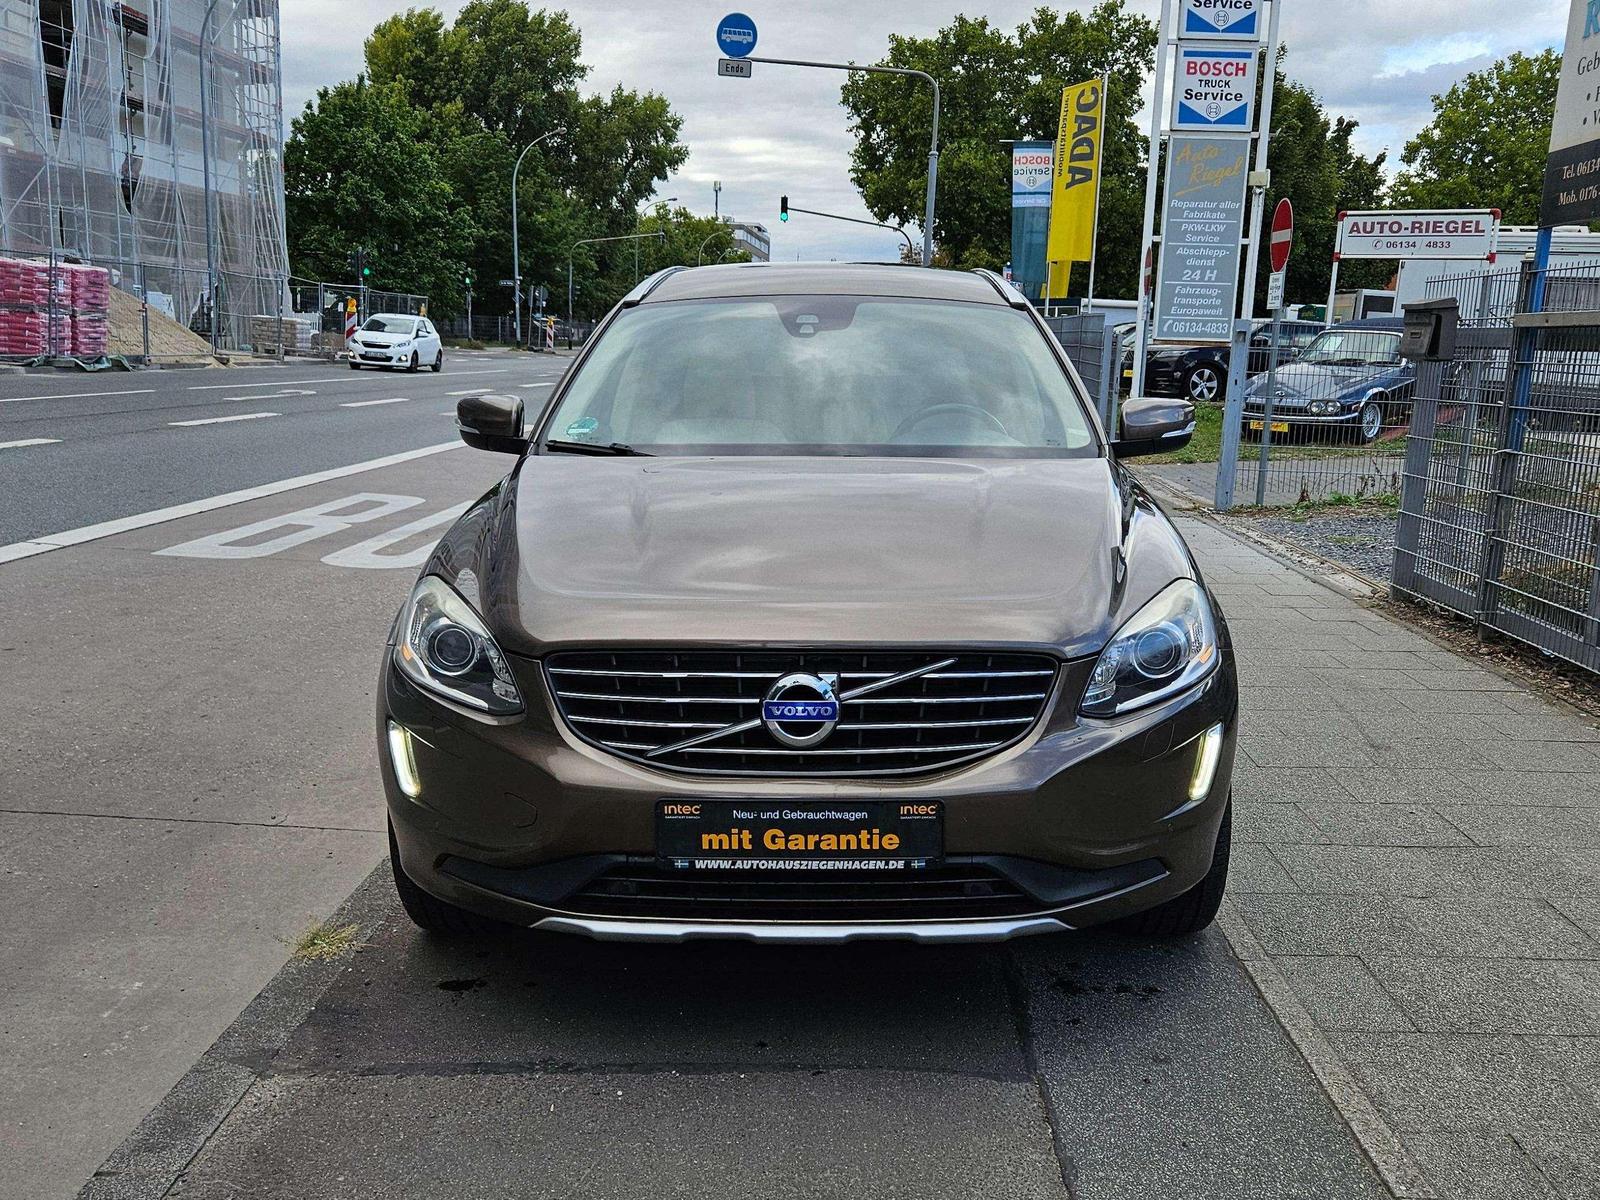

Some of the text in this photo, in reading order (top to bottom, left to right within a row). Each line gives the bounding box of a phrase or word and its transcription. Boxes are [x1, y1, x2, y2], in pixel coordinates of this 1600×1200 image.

[1192, 0, 1253, 9] Service
[725, 63, 744, 73] Ende
[1186, 60, 1248, 77] BOSCH
[1198, 79, 1231, 89] TRUCK
[1184, 88, 1243, 102] Service
[1562, 163, 1576, 180] Tel.
[1558, 190, 1578, 206] Mob.
[1170, 199, 1241, 209] Reparatur aller
[1183, 210, 1226, 219] Fabrikate
[1181, 223, 1227, 232] PKW-LKW
[1348, 220, 1486, 235] AUTO-RIEGEL
[1185, 233, 1220, 243] Service
[1386, 240, 1417, 249] 06134
[1425, 240, 1451, 249] 4833
[1176, 247, 1230, 257] Abschlepp-
[1186, 257, 1216, 266] dienst
[1182, 269, 1218, 281] 24 H
[1175, 285, 1222, 297] Fahrzeug-
[1173, 296, 1222, 306] transporte
[1170, 306, 1223, 316] Europaweit
[1172, 321, 1229, 334] 06134-4833
[768, 705, 833, 716] VOLVO
[664, 804, 701, 815] intec
[732, 809, 868, 821] Neu- und Gebrauchtwagen
[900, 804, 937, 815] intec
[701, 828, 901, 850] mit Garantie
[694, 859, 905, 870] WWW.AUTOHAUSZIEGENHAGEN.DE
